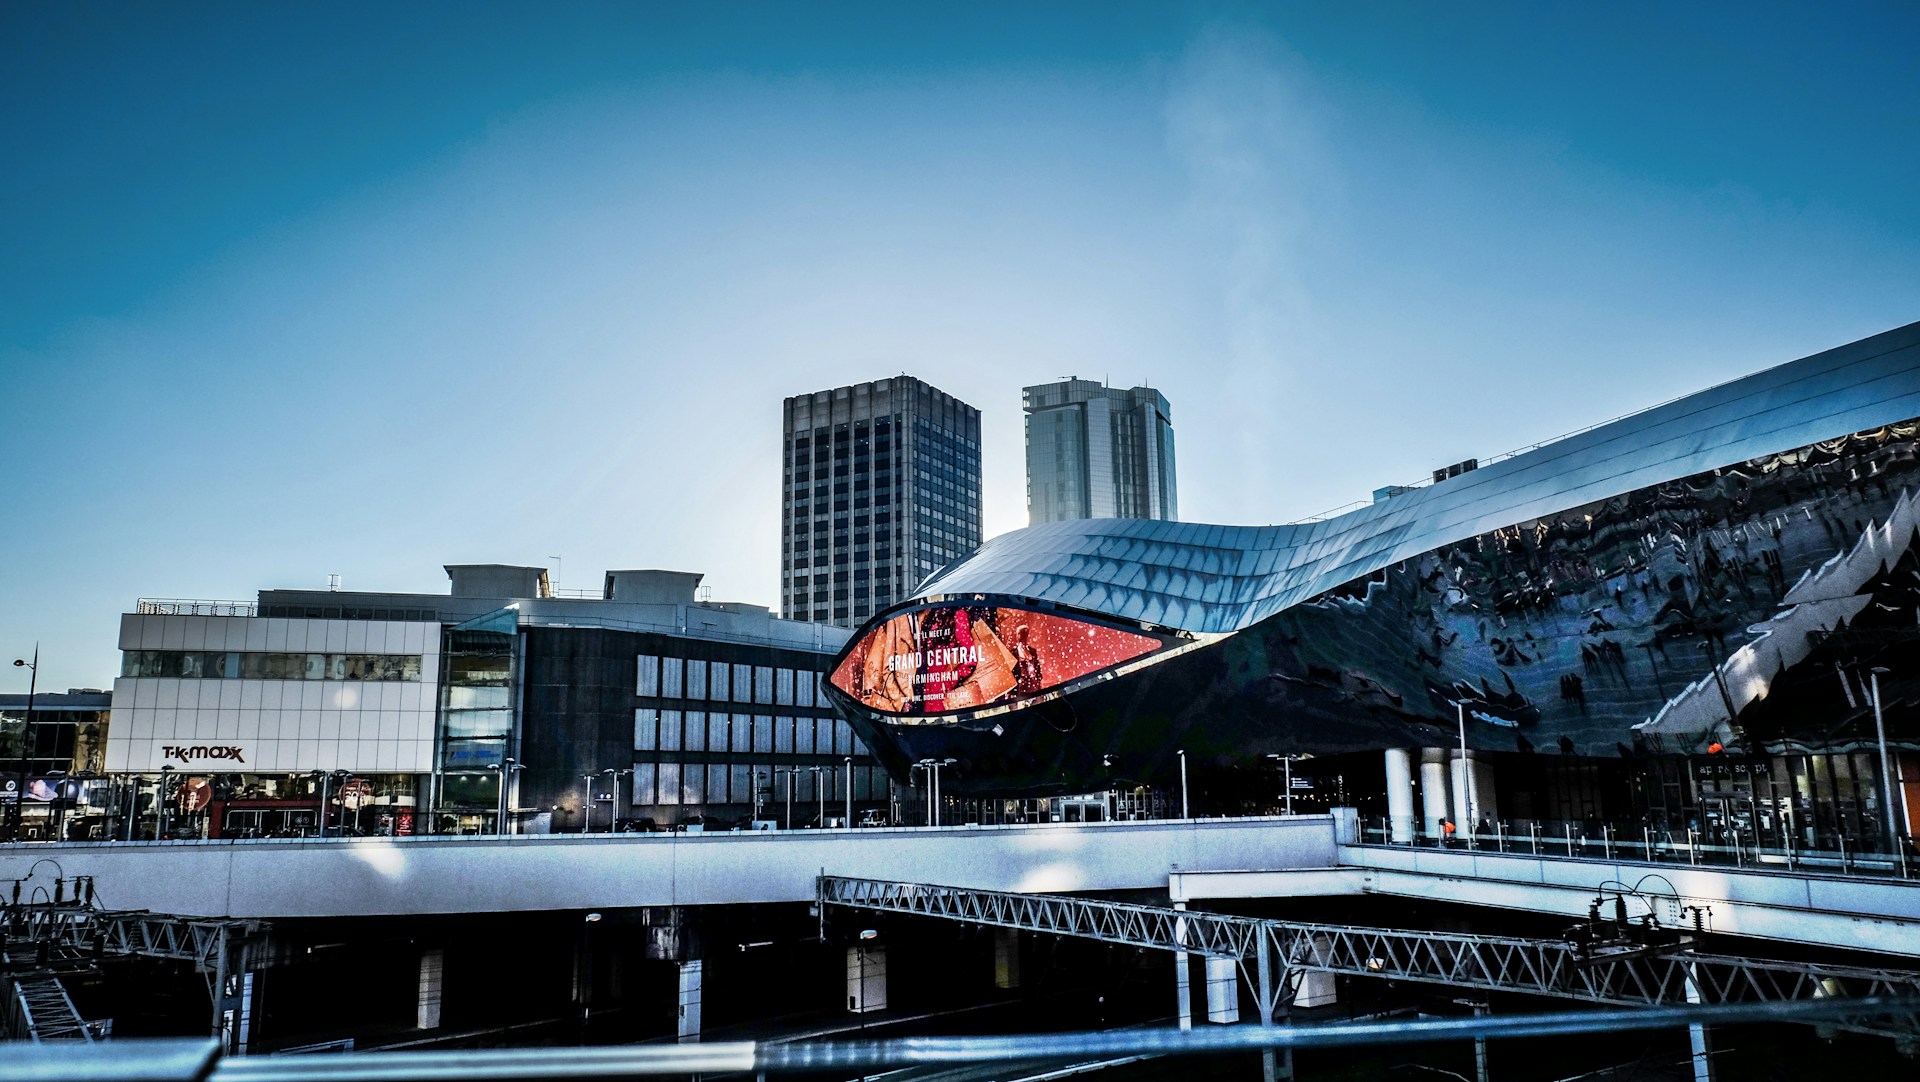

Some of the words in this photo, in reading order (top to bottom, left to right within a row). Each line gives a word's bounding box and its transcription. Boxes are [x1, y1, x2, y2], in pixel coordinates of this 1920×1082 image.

[929, 629, 942, 638] MEET
[944, 628, 951, 636] AT
[888, 651, 922, 672] GRAND
[927, 645, 986, 667] CENTRAL
[908, 671, 959, 684] BIRMINGHAM
